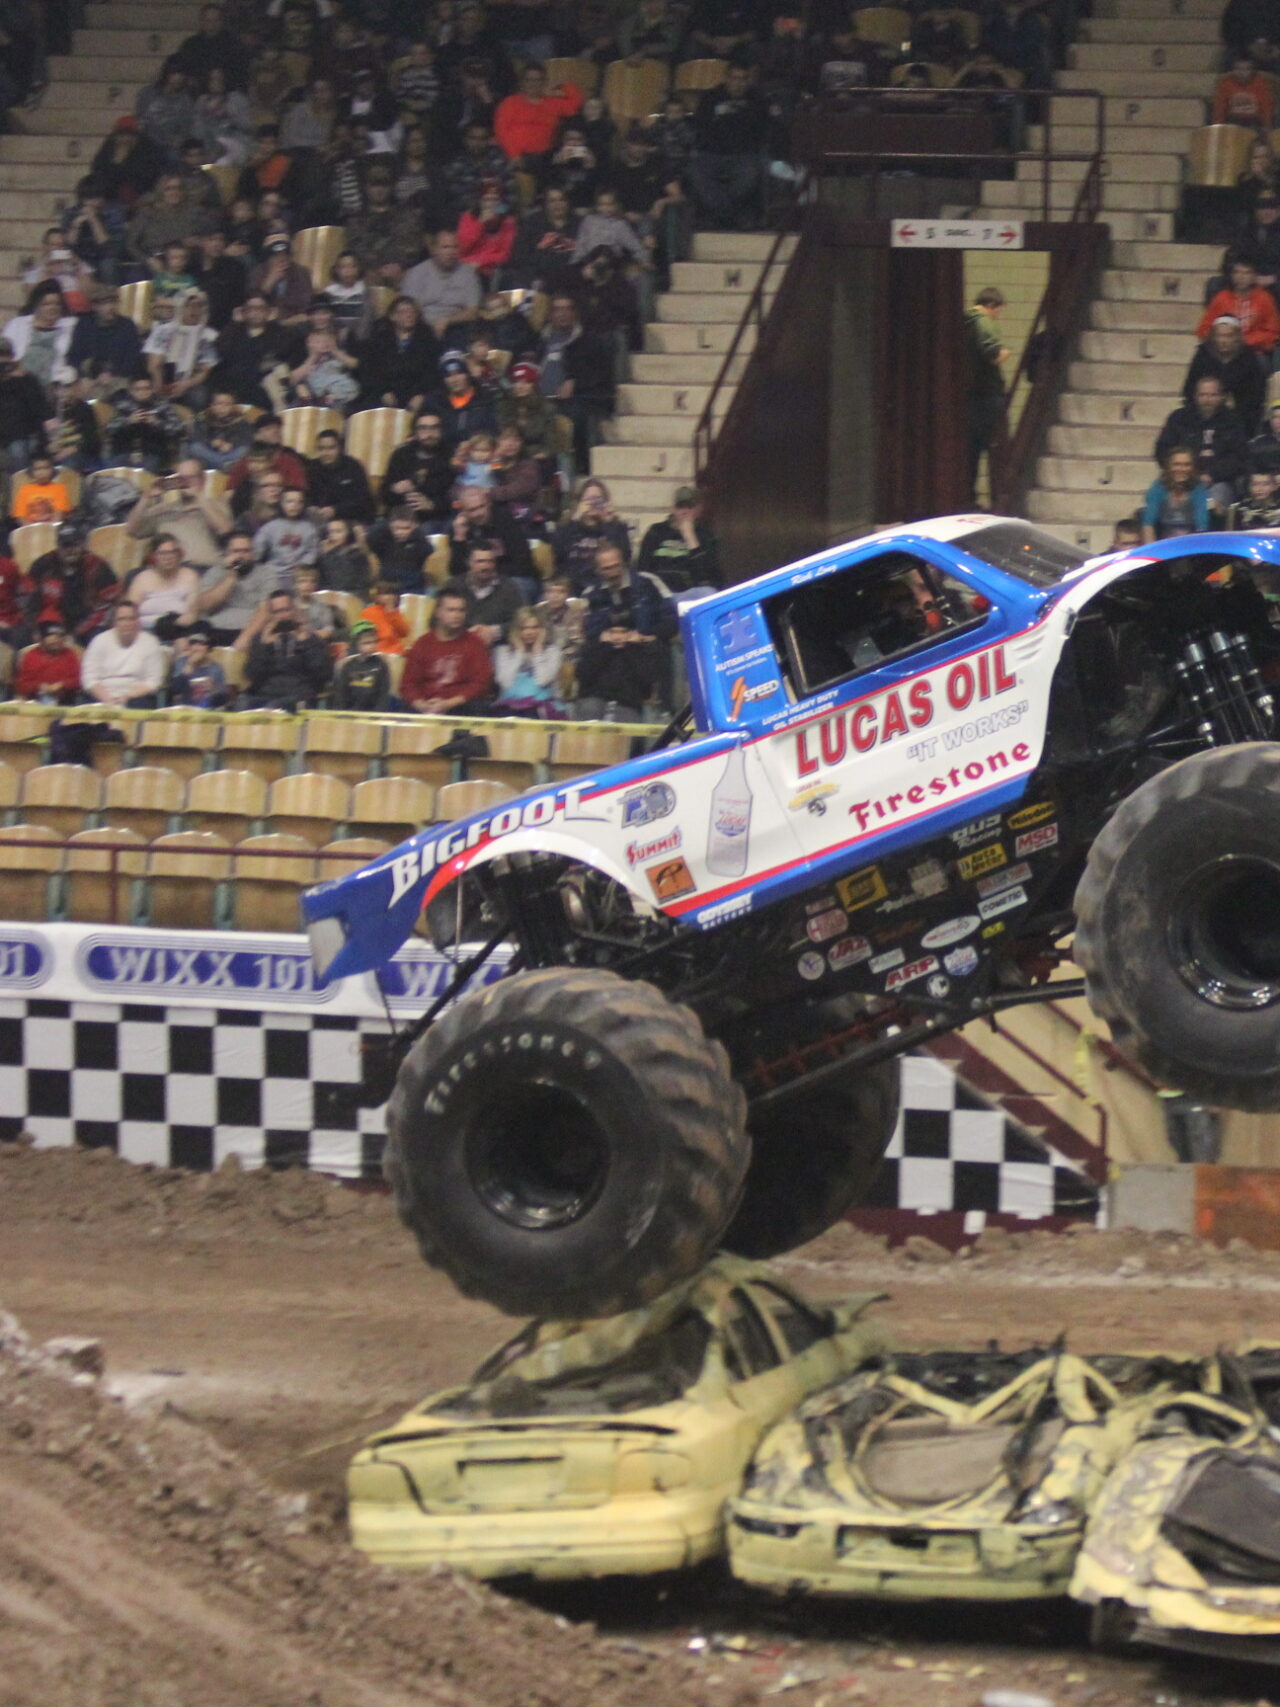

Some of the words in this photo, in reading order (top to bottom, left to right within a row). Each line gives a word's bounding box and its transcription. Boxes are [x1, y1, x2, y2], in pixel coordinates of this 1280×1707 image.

[698, 327, 713, 349] L
[1139, 338, 1155, 359] L
[673, 390, 689, 411] K
[1119, 400, 1135, 421] K
[652, 452, 667, 473] J
[1098, 465, 1114, 486] J
[742, 679, 780, 702] SPEED
[762, 709, 789, 726] LUCAS
[789, 697, 817, 715] HEAVY
[817, 689, 840, 706] DUTY
[794, 679, 934, 779] LUCAS
[946, 645, 1018, 712] OIL
[848, 741, 1031, 832] Firestone
[356, 780, 612, 909] BIGFOOT
[1017, 825, 1057, 849] MSD
[982, 891, 1022, 913] COMETIC
[108, 947, 237, 988] WIXX
[253, 956, 312, 992] 101
[886, 956, 934, 986] ARP
